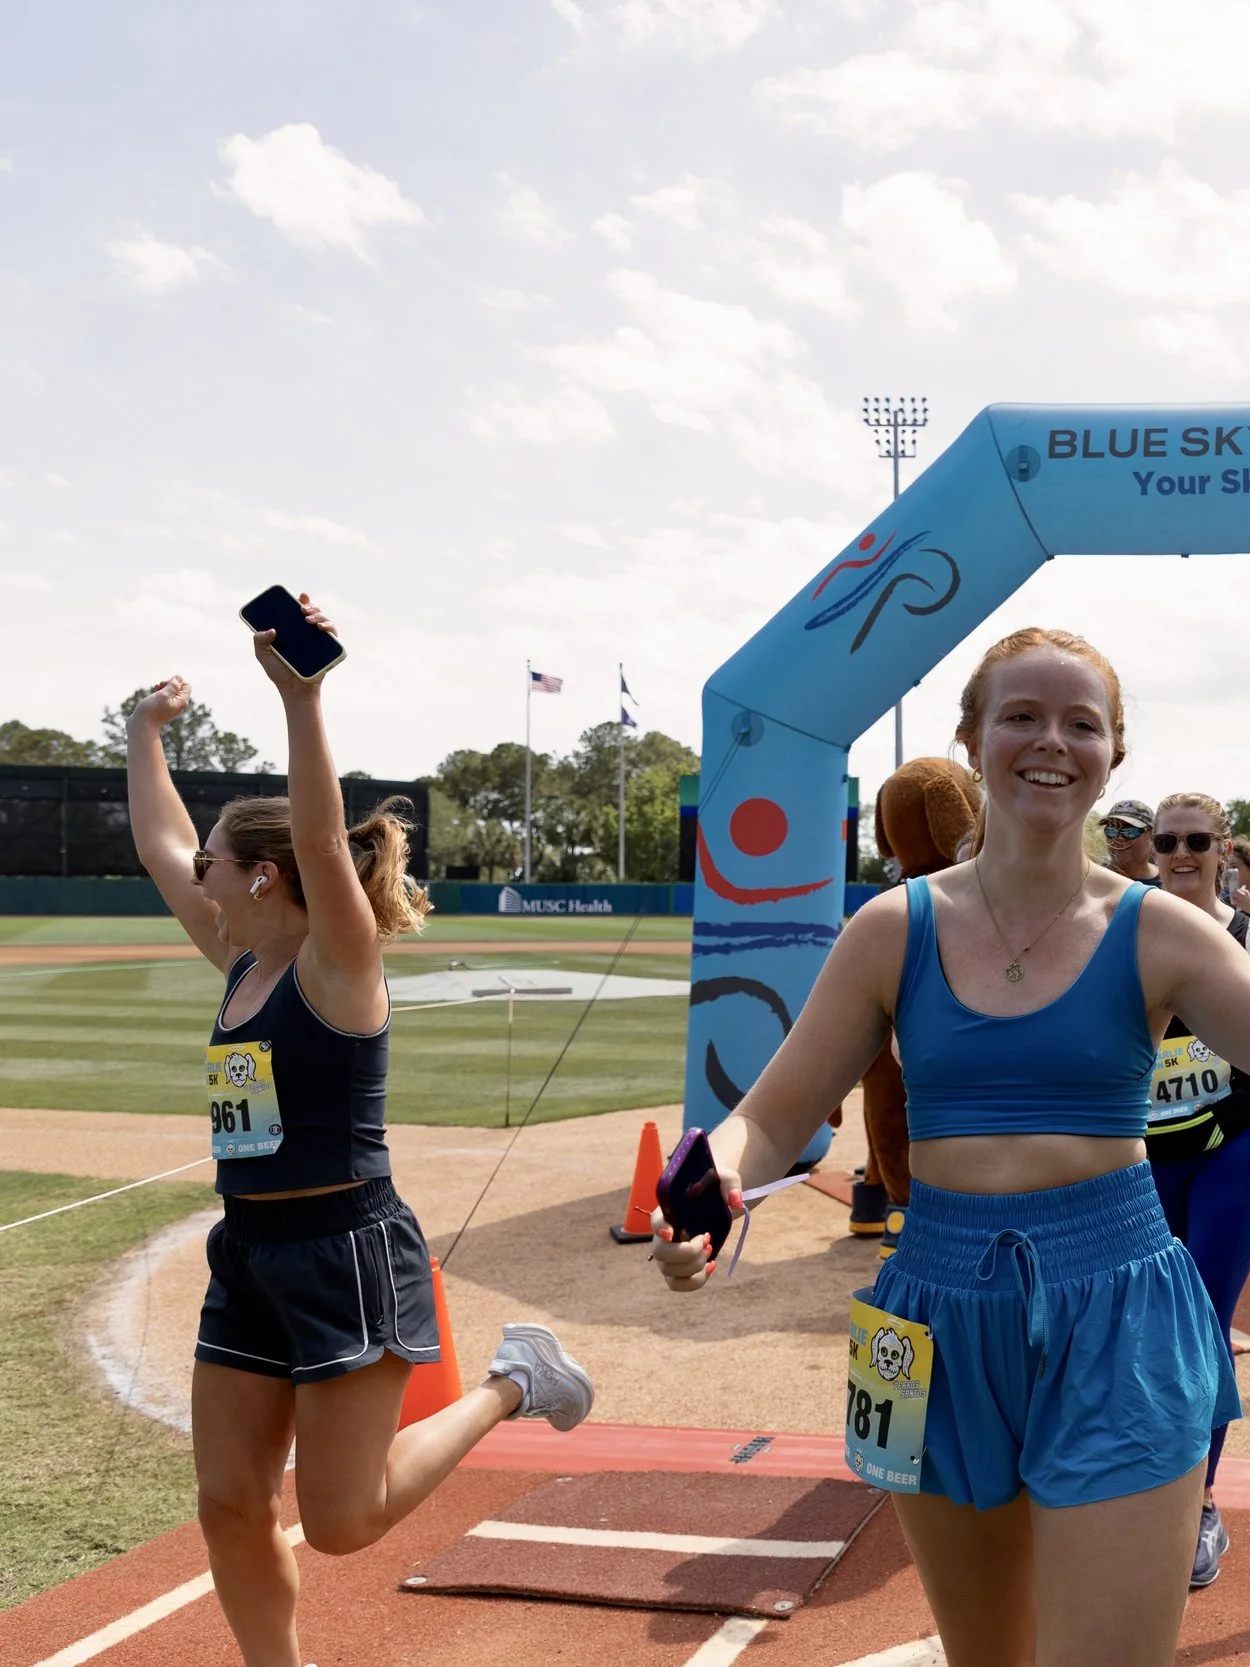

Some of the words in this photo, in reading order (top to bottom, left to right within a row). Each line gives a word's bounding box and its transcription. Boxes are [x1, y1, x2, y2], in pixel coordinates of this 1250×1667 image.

[1048, 428, 1168, 459] BLUE
[1132, 471, 1211, 496] Your
[522, 899, 566, 913] MUSC
[568, 899, 613, 913] Health
[1164, 1057, 1179, 1068] 5K
[209, 1074, 218, 1086] 5K
[1156, 1069, 1218, 1103] 4710
[209, 1099, 251, 1134] 961
[238, 1144, 255, 1153] ONE
[866, 1462, 885, 1480] ONE
[886, 1470, 917, 1486] BEER
